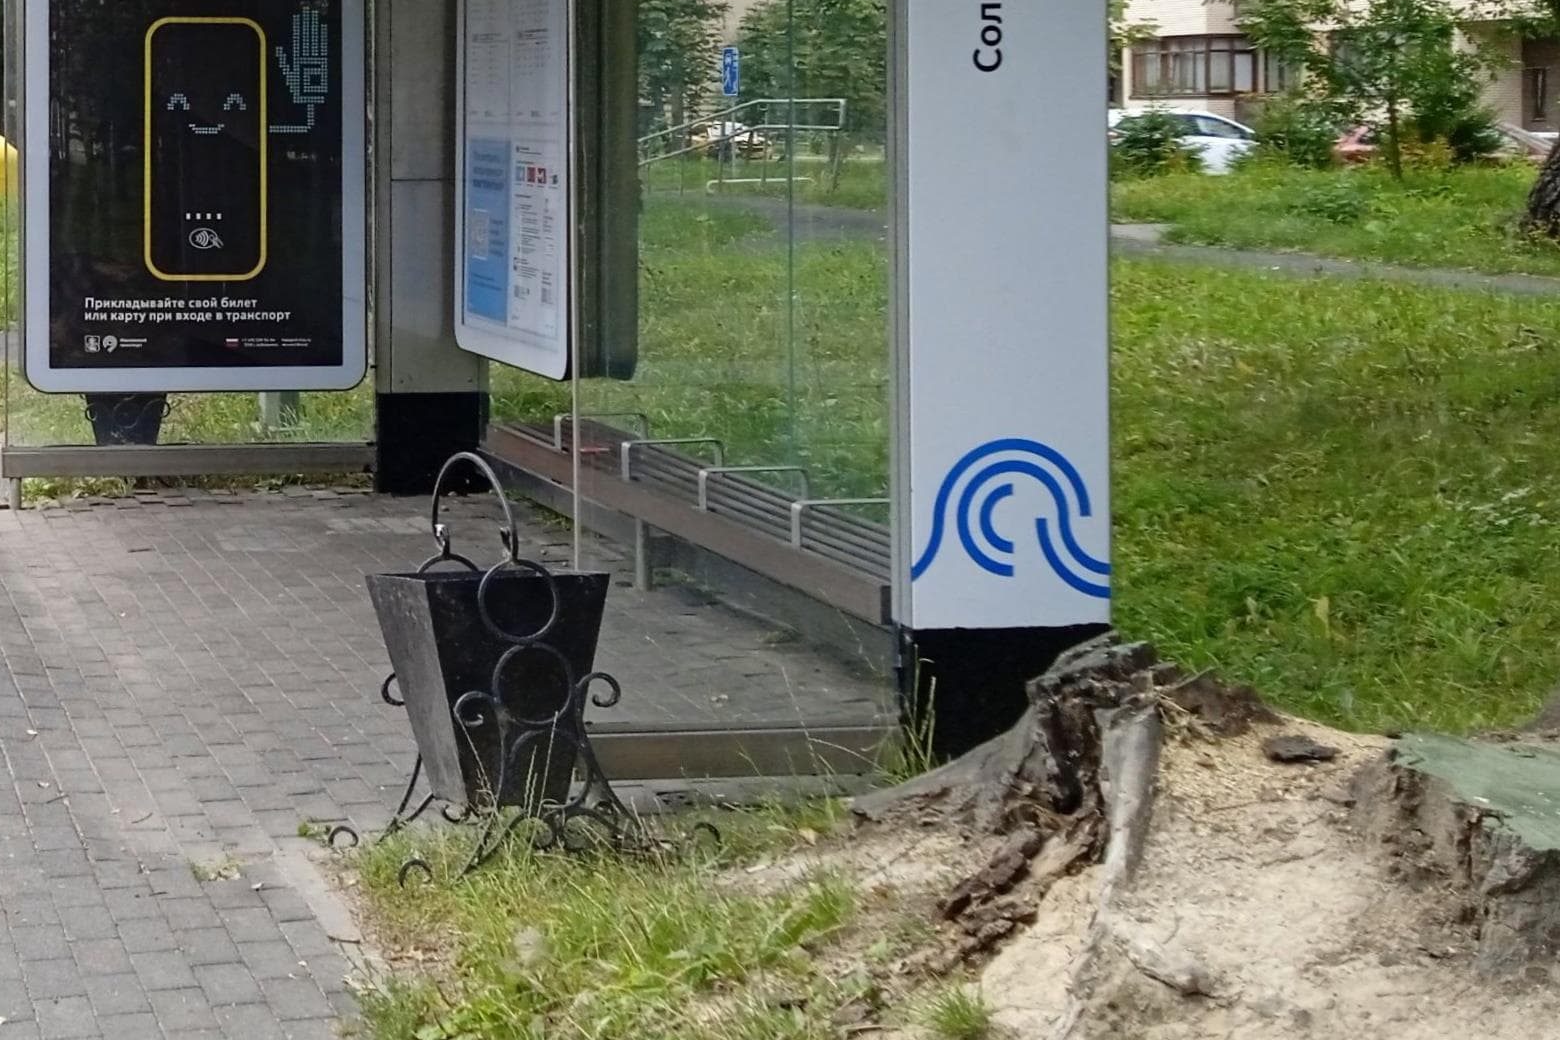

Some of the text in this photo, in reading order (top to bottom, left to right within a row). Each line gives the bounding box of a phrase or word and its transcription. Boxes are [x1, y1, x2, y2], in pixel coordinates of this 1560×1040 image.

[84, 296, 258, 310] Прикладывайте свой билет
[84, 311, 291, 323] или карту при входе в транспорт
